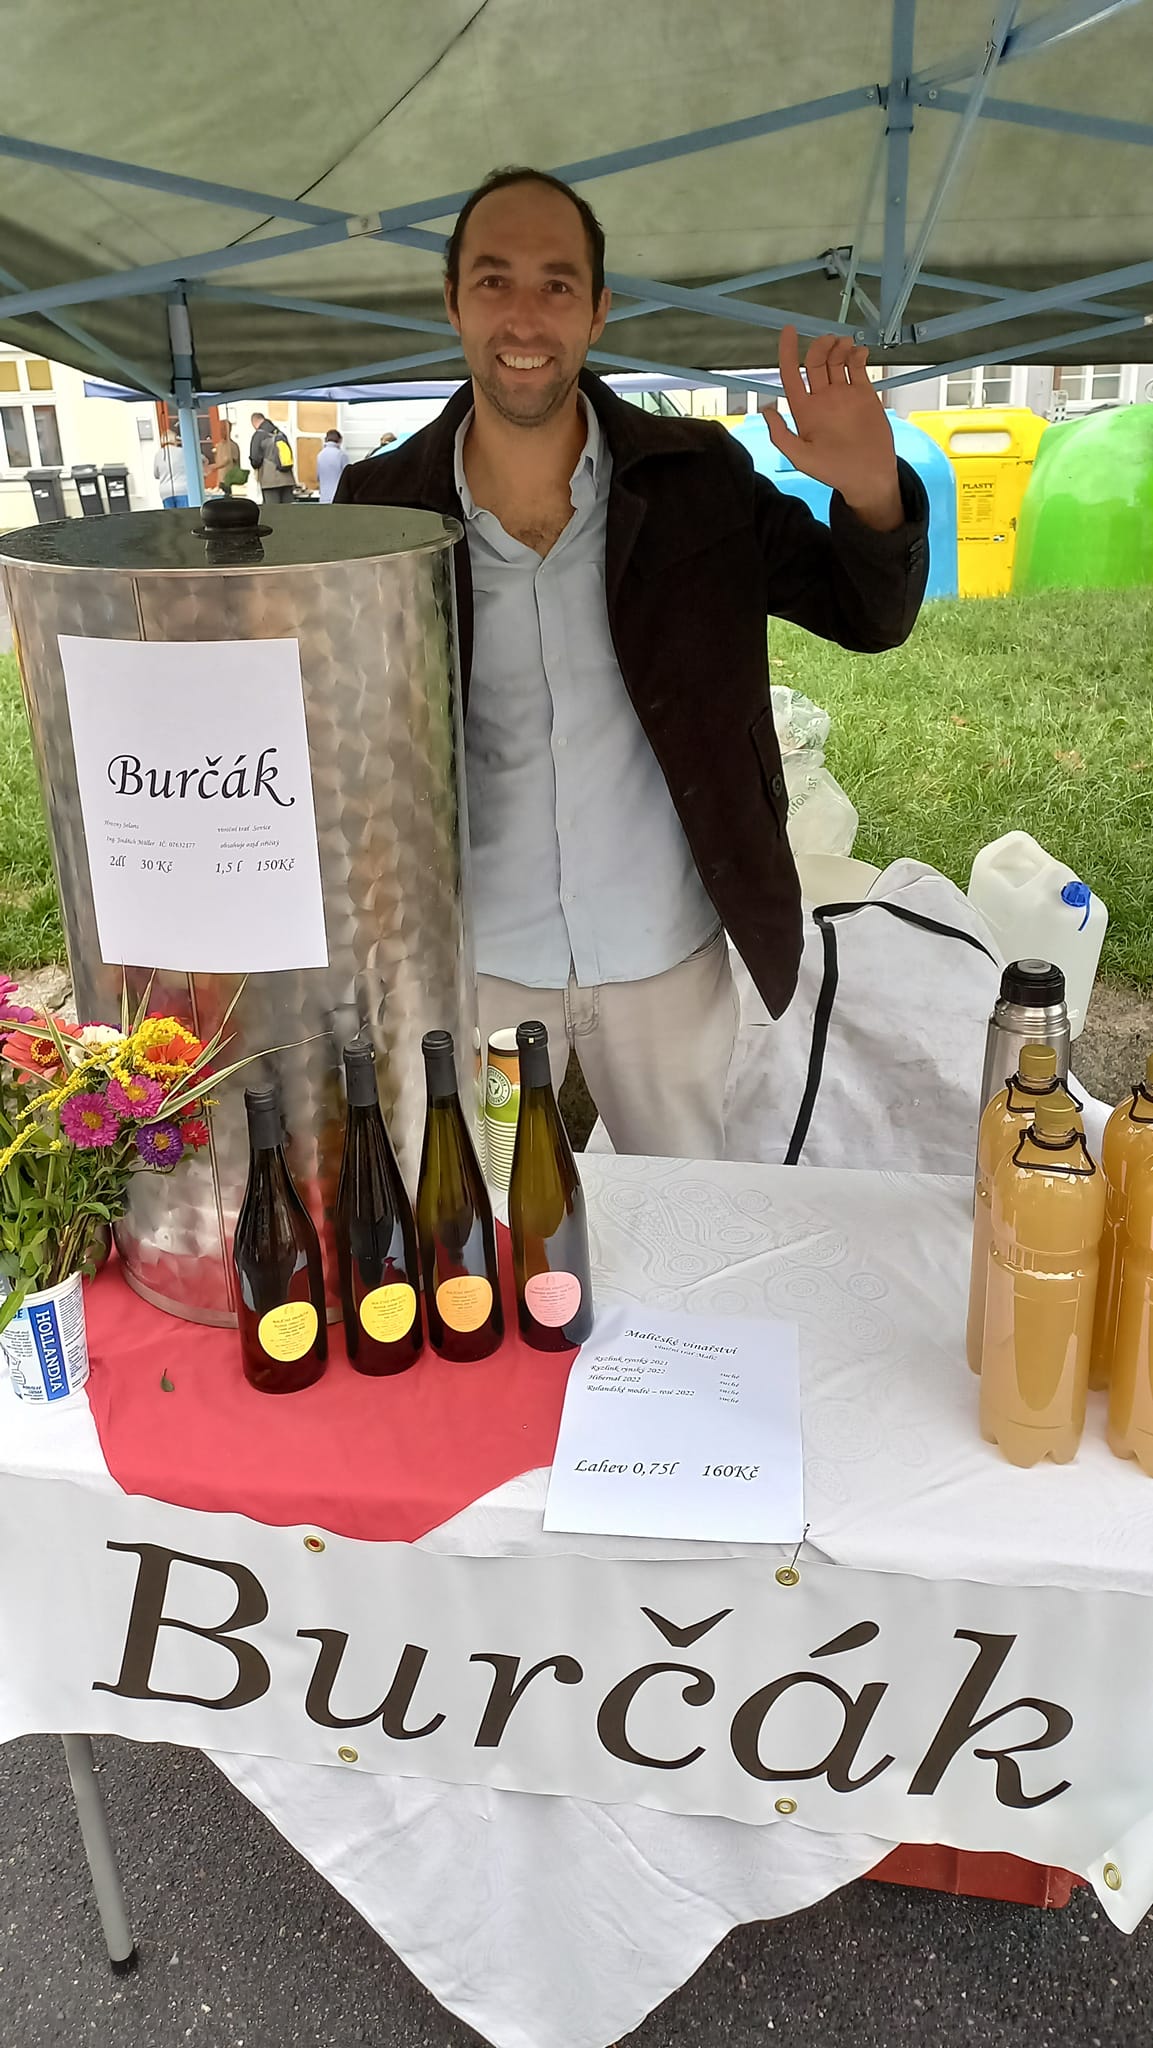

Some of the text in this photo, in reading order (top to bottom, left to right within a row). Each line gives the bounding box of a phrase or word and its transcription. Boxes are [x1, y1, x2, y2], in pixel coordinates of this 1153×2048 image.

[108, 748, 295, 806] Burčák
[110, 855, 174, 874] 2dl 30 Kč
[216, 862, 232, 874] 1,5
[257, 857, 296, 872] 150Kč
[36, 1310, 64, 1393] HOLLANDIA
[574, 1459, 760, 1480] Lahev 0,75l 160Kč
[92, 1539, 1074, 1809] Burčák
